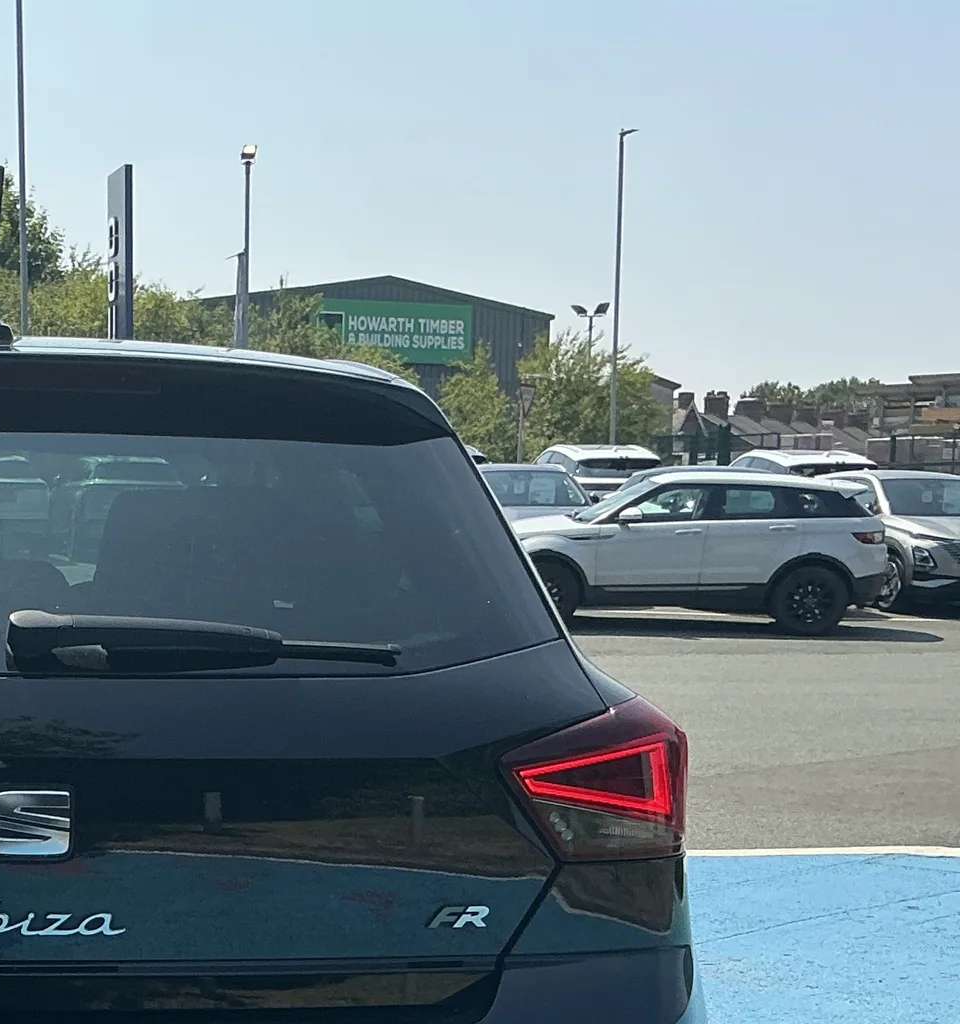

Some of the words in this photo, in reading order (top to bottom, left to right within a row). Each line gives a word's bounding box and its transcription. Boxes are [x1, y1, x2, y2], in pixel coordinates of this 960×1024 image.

[348, 315, 414, 333] HOWARTH
[418, 318, 464, 335] TIMBER
[358, 333, 410, 348] BUILDING
[412, 335, 465, 350] SUPPLIES
[428, 905, 490, 929] FR
